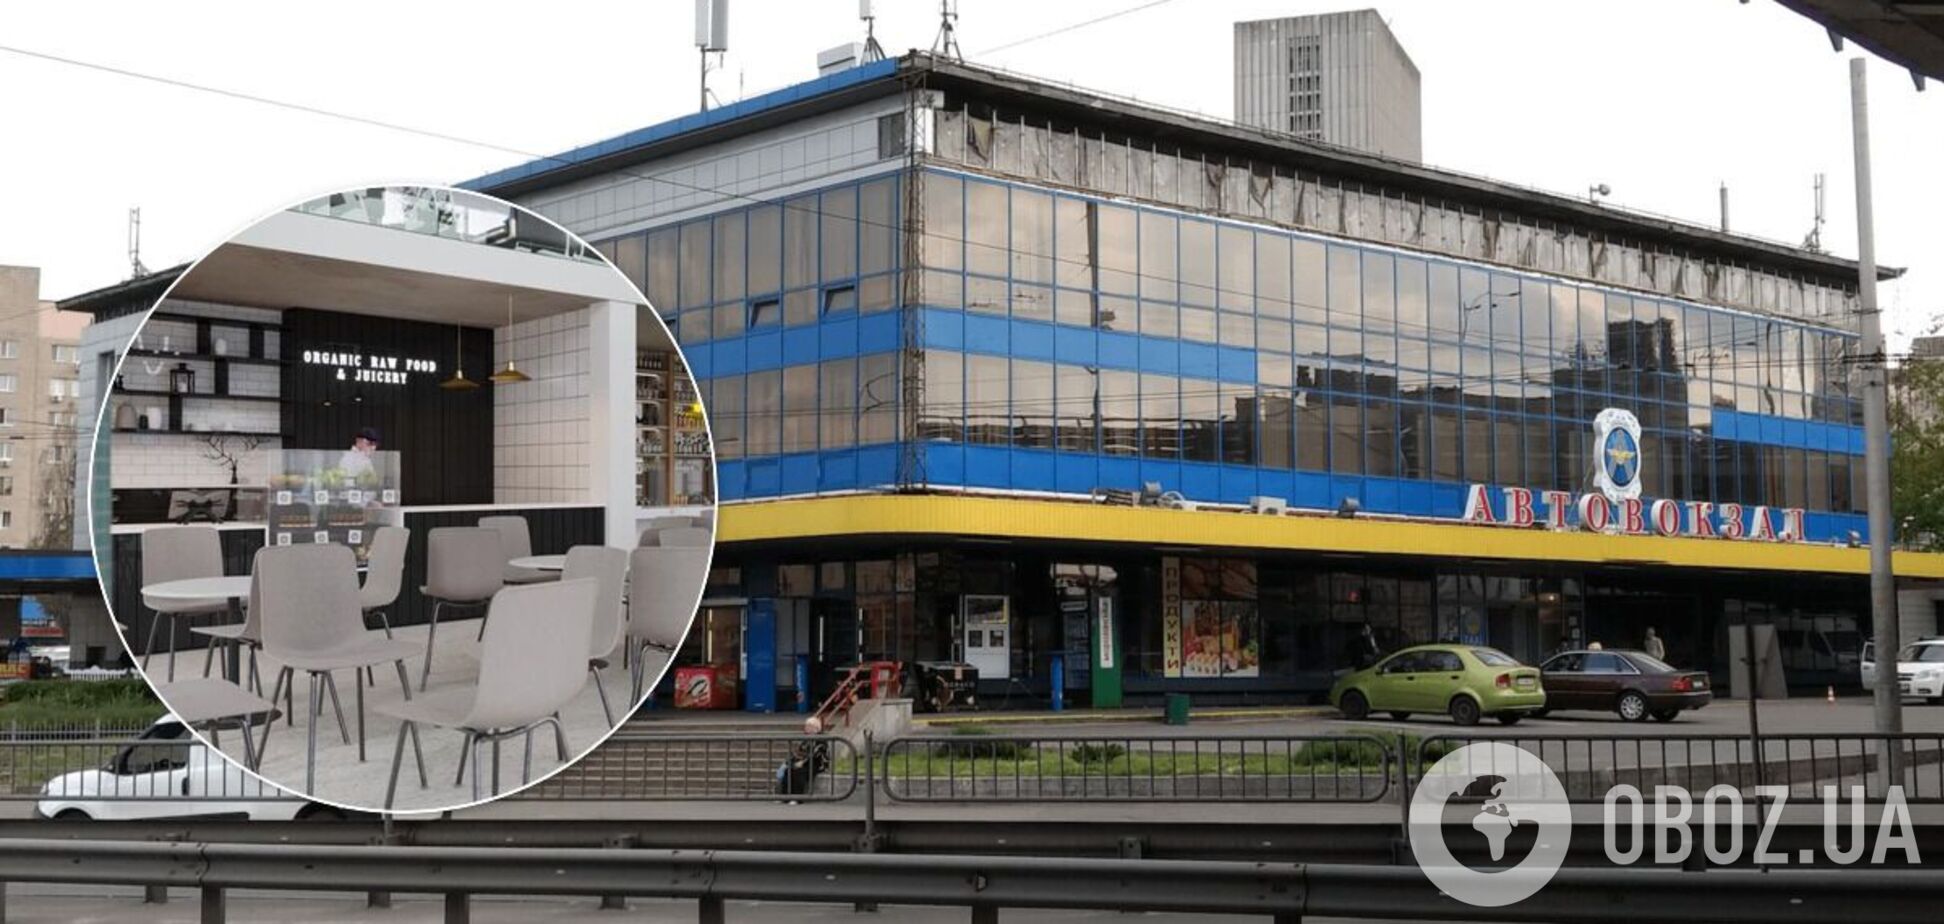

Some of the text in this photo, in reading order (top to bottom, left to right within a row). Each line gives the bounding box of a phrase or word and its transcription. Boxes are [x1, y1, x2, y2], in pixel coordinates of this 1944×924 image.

[303, 350, 437, 372] ORGANIC RAW FOOD
[336, 368, 407, 384] & JUICERY
[1464, 484, 1805, 542] АВТОВОКЗАЛ
[1166, 566, 1179, 669] ПРОДУКТИ
